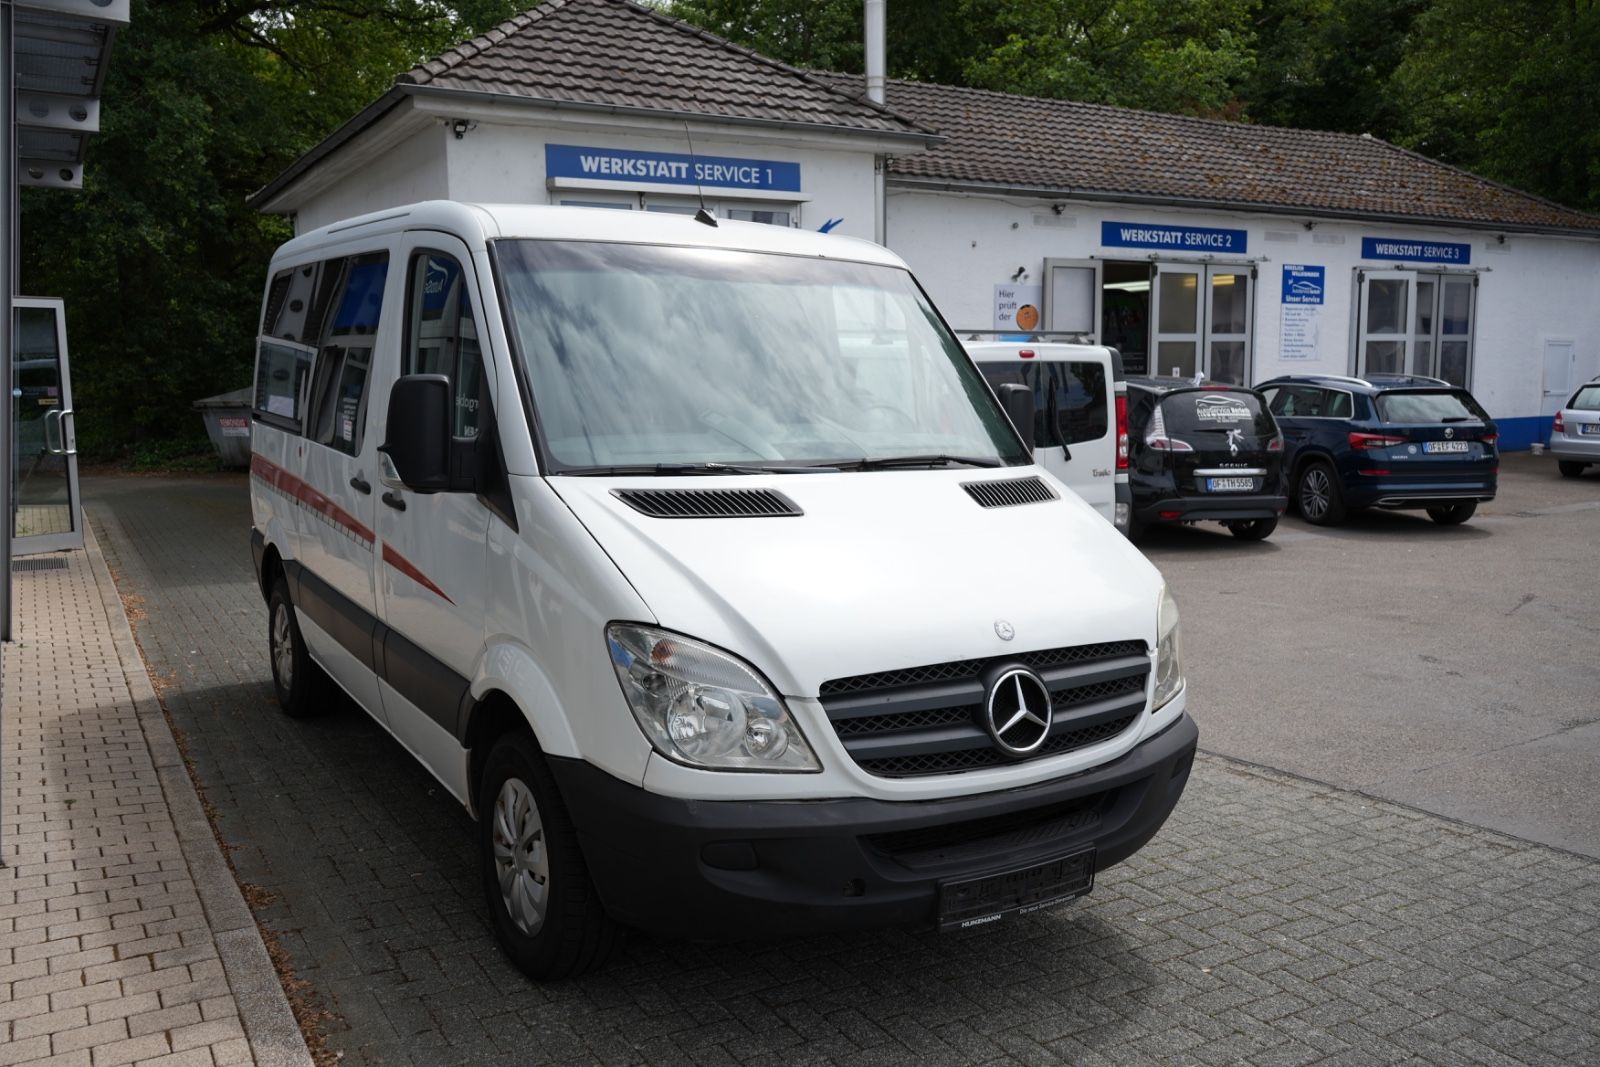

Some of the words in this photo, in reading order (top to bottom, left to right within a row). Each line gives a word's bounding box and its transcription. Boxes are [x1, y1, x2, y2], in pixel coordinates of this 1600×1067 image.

[580, 155, 688, 179] WERKSTATT
[694, 163, 760, 184] SERVICE
[766, 169, 773, 185] 1
[1120, 228, 1182, 244] WERKSTATT
[1184, 230, 1223, 247] SERVICE
[1225, 234, 1232, 247] 2
[1375, 243, 1422, 257] WERKSTATT
[1423, 246, 1453, 259] SERVICE
[1454, 248, 1460, 259] 3
[998, 289, 1015, 299] Hier
[1285, 294, 1302, 303] Unser
[1302, 295, 1320, 303] Service
[998, 301, 1017, 311] prüft
[998, 311, 1011, 321] der
[1428, 442, 1436, 451] OF
[1212, 479, 1222, 488] OF
[1227, 479, 1236, 488] TH
[1237, 478, 1253, 488] 5585
